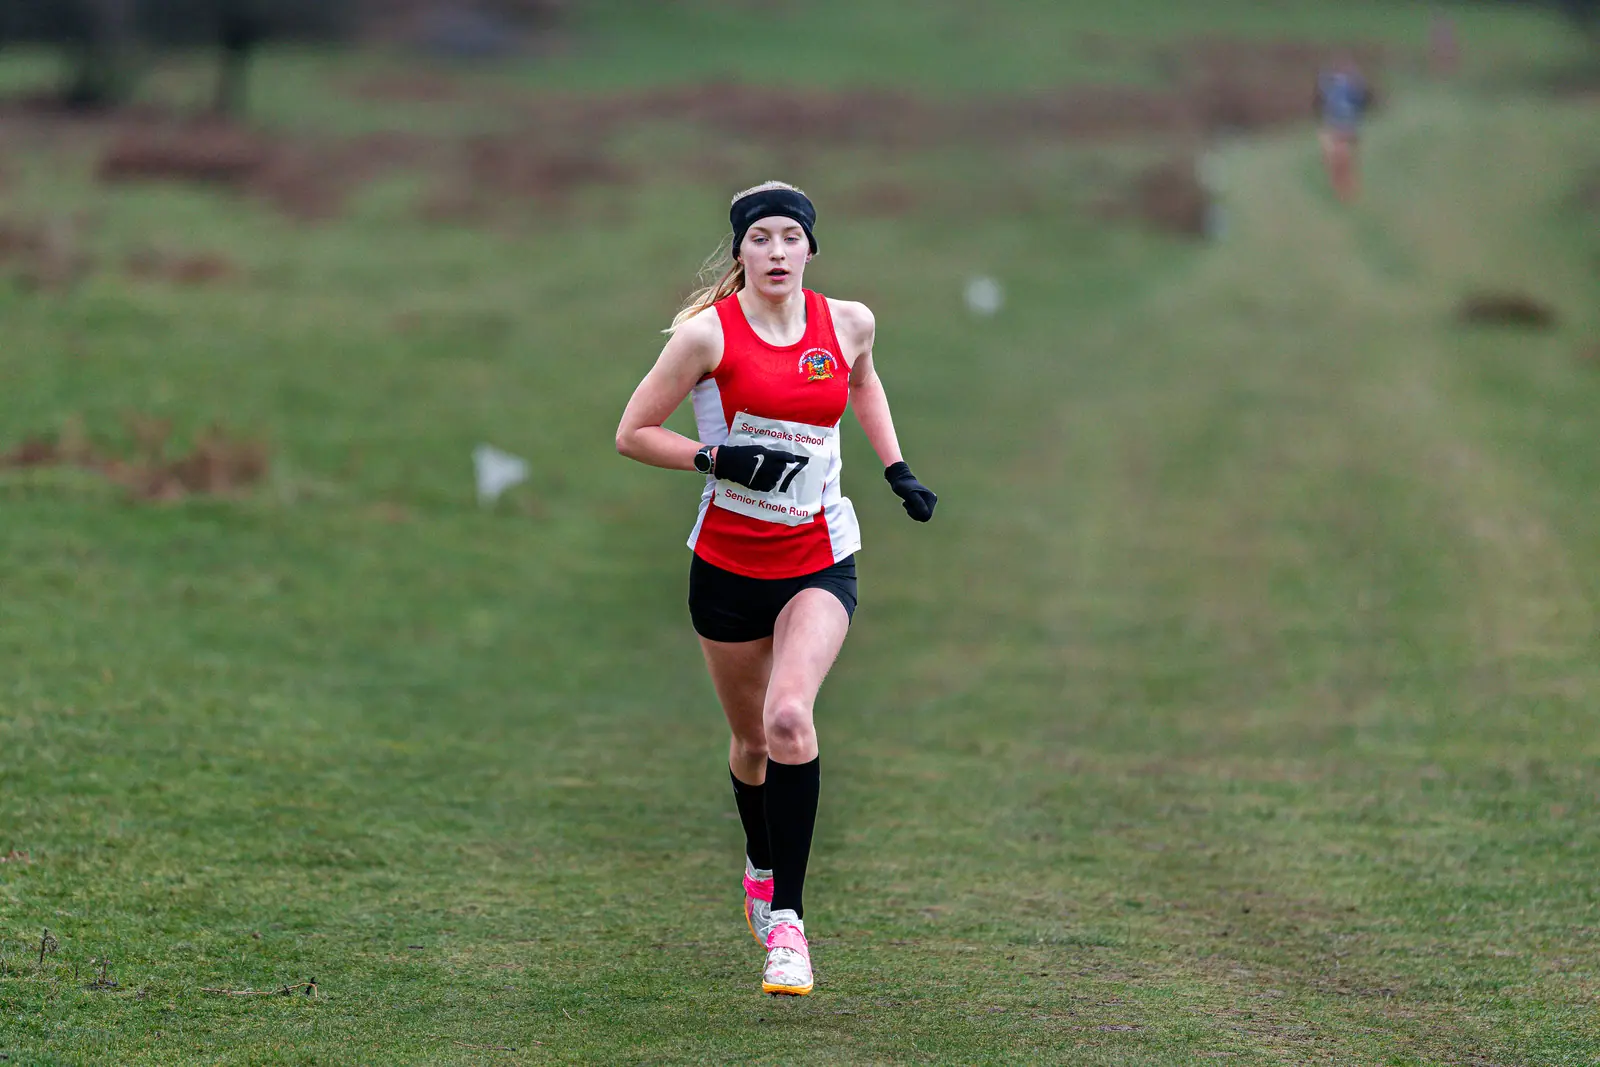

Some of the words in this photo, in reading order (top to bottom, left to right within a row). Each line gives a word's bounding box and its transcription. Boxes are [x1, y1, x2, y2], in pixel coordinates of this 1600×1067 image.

[741, 422, 793, 442] Sevenoaks
[794, 433, 824, 446] School
[724, 488, 756, 506] Senior
[758, 499, 787, 514] Knole
[788, 506, 809, 517] Run
